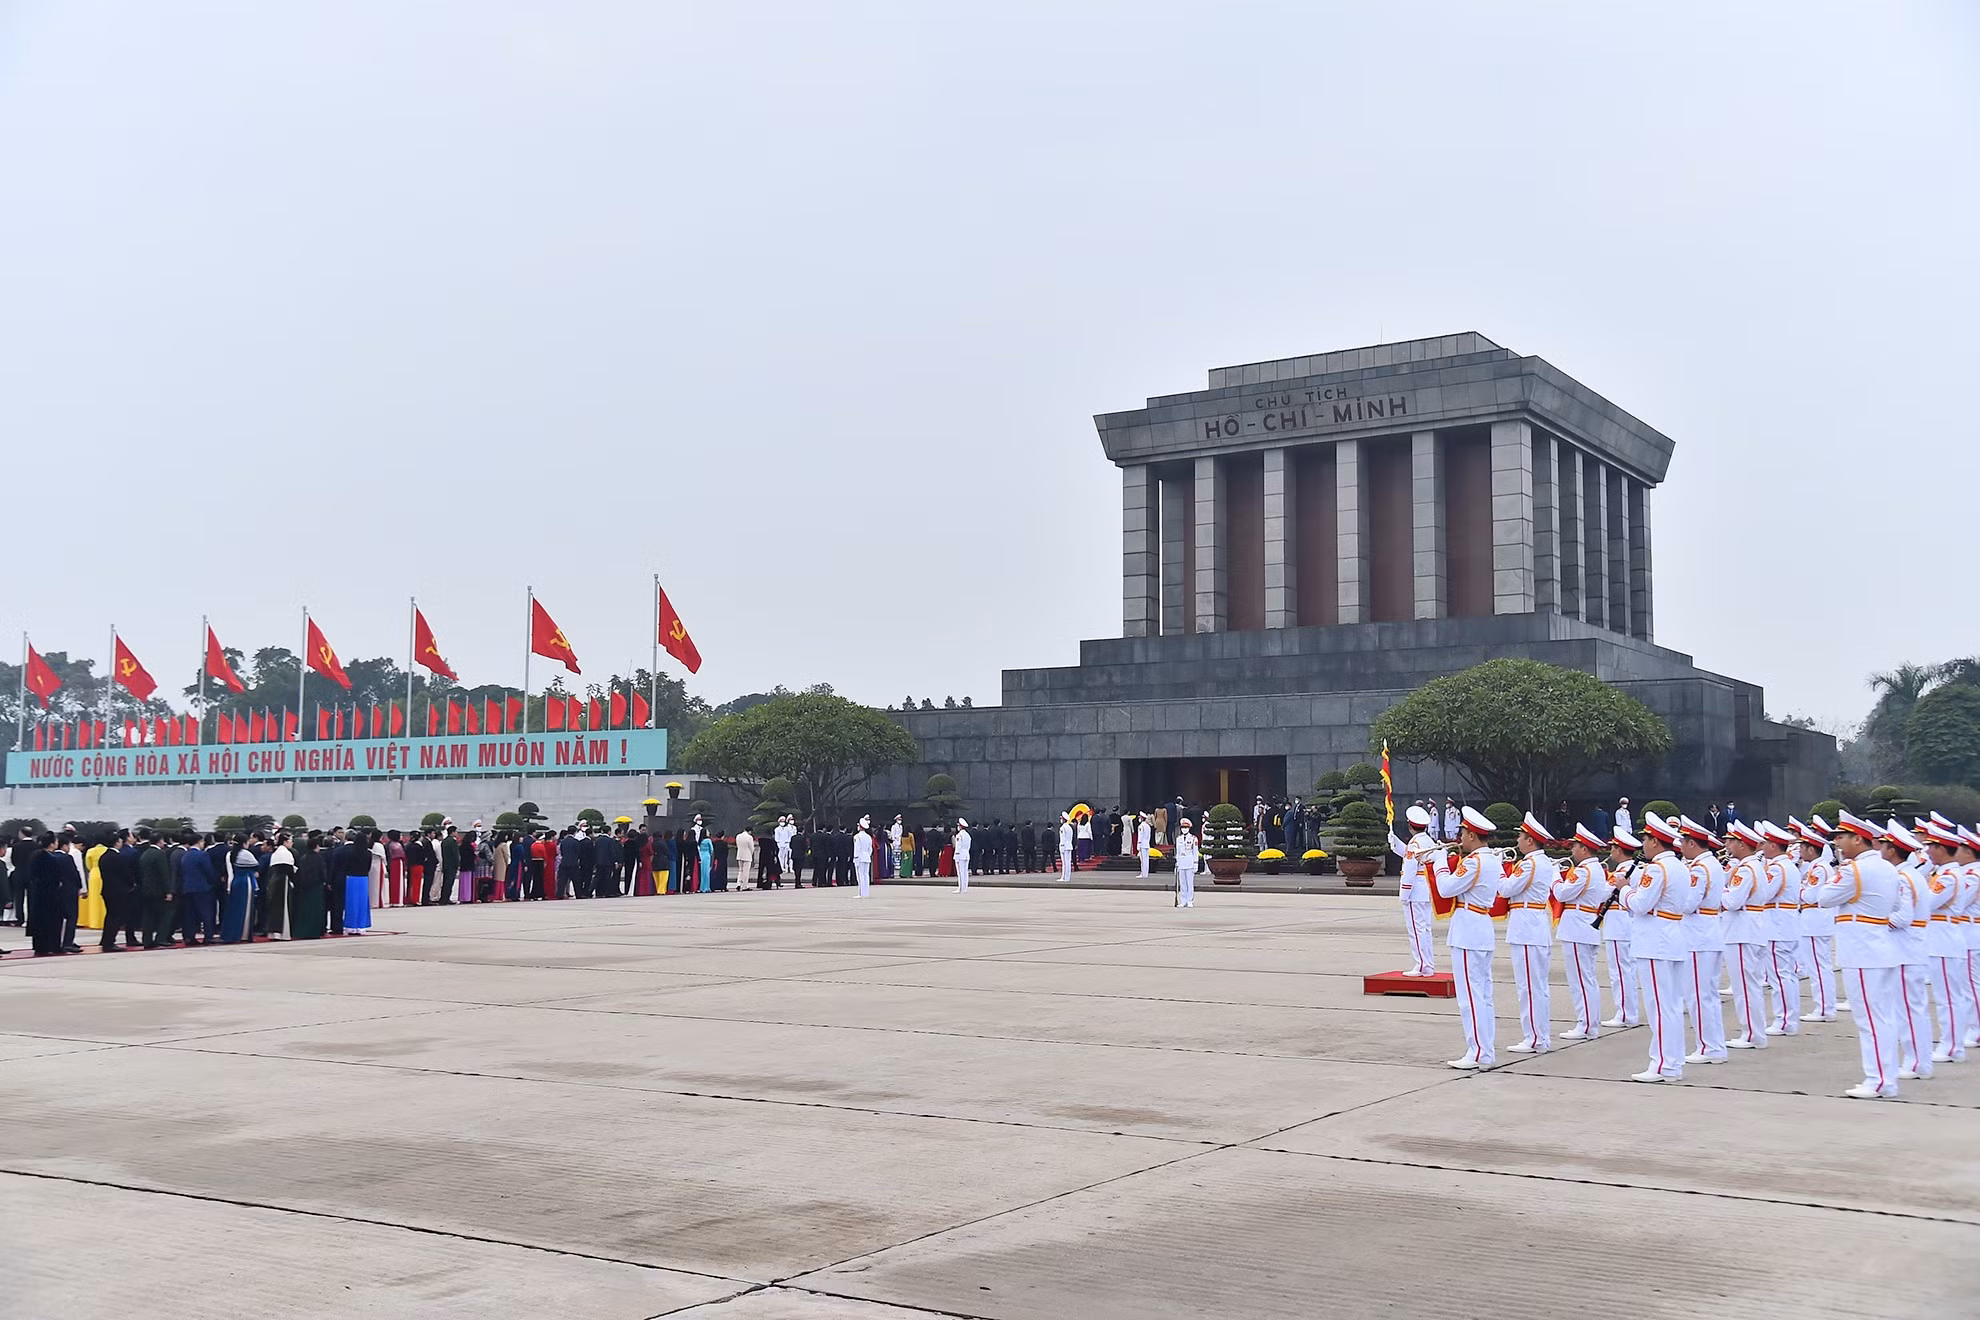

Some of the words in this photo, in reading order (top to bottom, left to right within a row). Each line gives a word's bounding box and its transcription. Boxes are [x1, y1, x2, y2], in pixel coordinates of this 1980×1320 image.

[1205, 414, 1240, 439] HỒ
[1263, 404, 1307, 431] CHÍ
[1333, 396, 1407, 423] MINH
[1255, 390, 1291, 409] CHỦ
[1305, 387, 1347, 406] TỊCH
[30, 754, 74, 778] NƯỚC
[82, 752, 127, 780] CỘNG
[135, 750, 169, 776] HÒA
[177, 749, 200, 774] XÃ
[209, 747, 240, 777] HỘI
[248, 743, 286, 773] CHỦ
[294, 743, 355, 772] NGHĨA
[366, 742, 410, 773] VIỆT
[420, 743, 468, 769] NAM
[478, 737, 545, 768] MUÔN
[555, 734, 609, 765] NĂM
